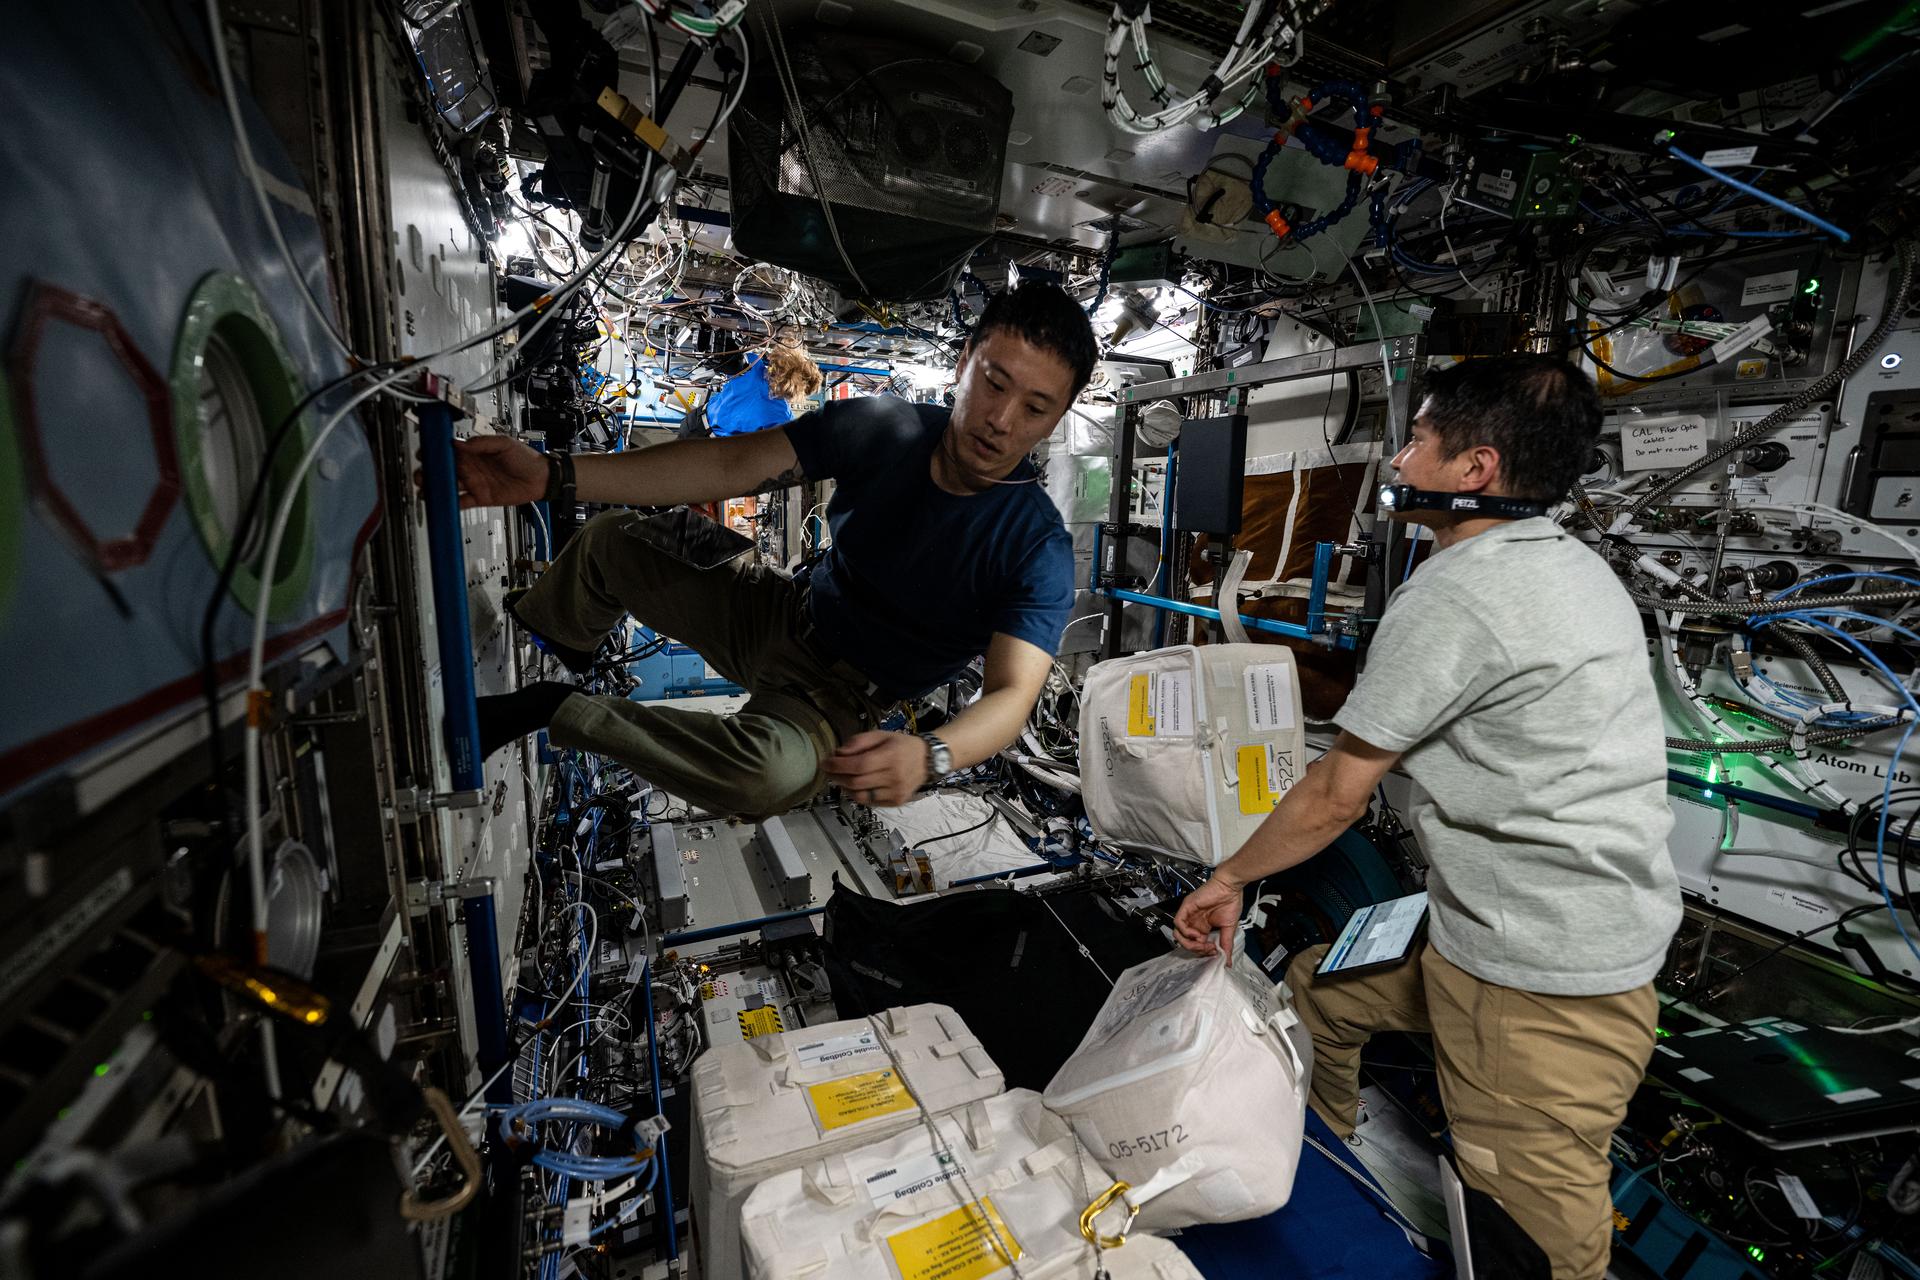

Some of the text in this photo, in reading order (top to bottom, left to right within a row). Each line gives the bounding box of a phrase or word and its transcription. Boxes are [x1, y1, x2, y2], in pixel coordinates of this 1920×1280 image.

[1632, 428, 1652, 438] CAL
[1660, 426, 1678, 434] Fiber
[1643, 436, 1666, 445] cables
[1636, 448, 1646, 456] Do
[1665, 444, 1700, 454] re-route
[1452, 498, 1531, 512] PETZL TIKKA
[1774, 681, 1802, 690] Science
[1816, 753, 1866, 774] Atom
[820, 1045, 880, 1062] Double Coldbag
[895, 1180, 933, 1198] Coldbag
